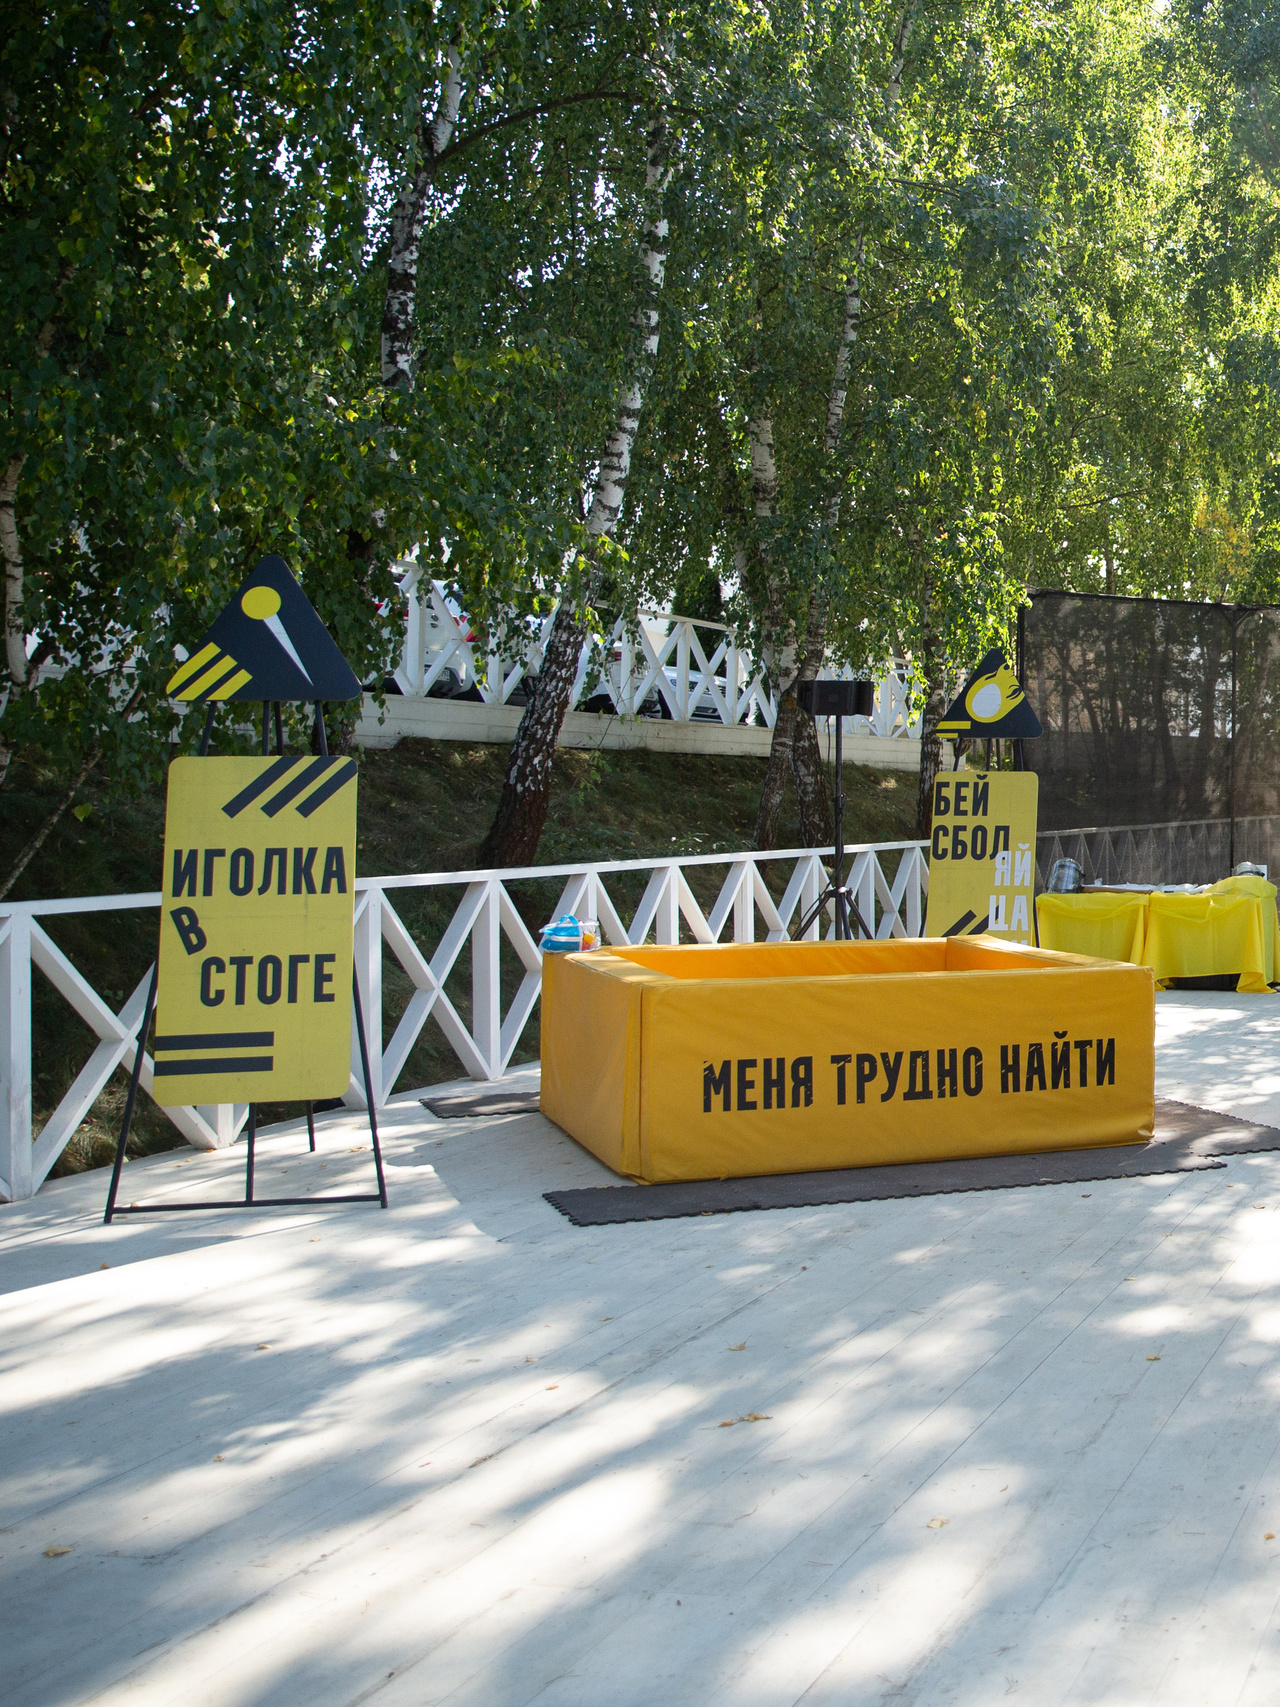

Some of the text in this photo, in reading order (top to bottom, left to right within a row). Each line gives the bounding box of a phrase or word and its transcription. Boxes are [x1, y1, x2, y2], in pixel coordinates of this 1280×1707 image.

[934, 774, 989, 816] БЕЙ
[932, 824, 1010, 860] СБОЛ
[994, 843, 1032, 886] ЯЙ
[172, 847, 347, 897] ИГОЛКА
[170, 906, 207, 955] В
[988, 895, 1029, 931] ЦА
[200, 954, 336, 1007] СТОГЕ
[703, 1030, 1116, 1113] МЕНЯ ТРУДНО НАЙТИ
